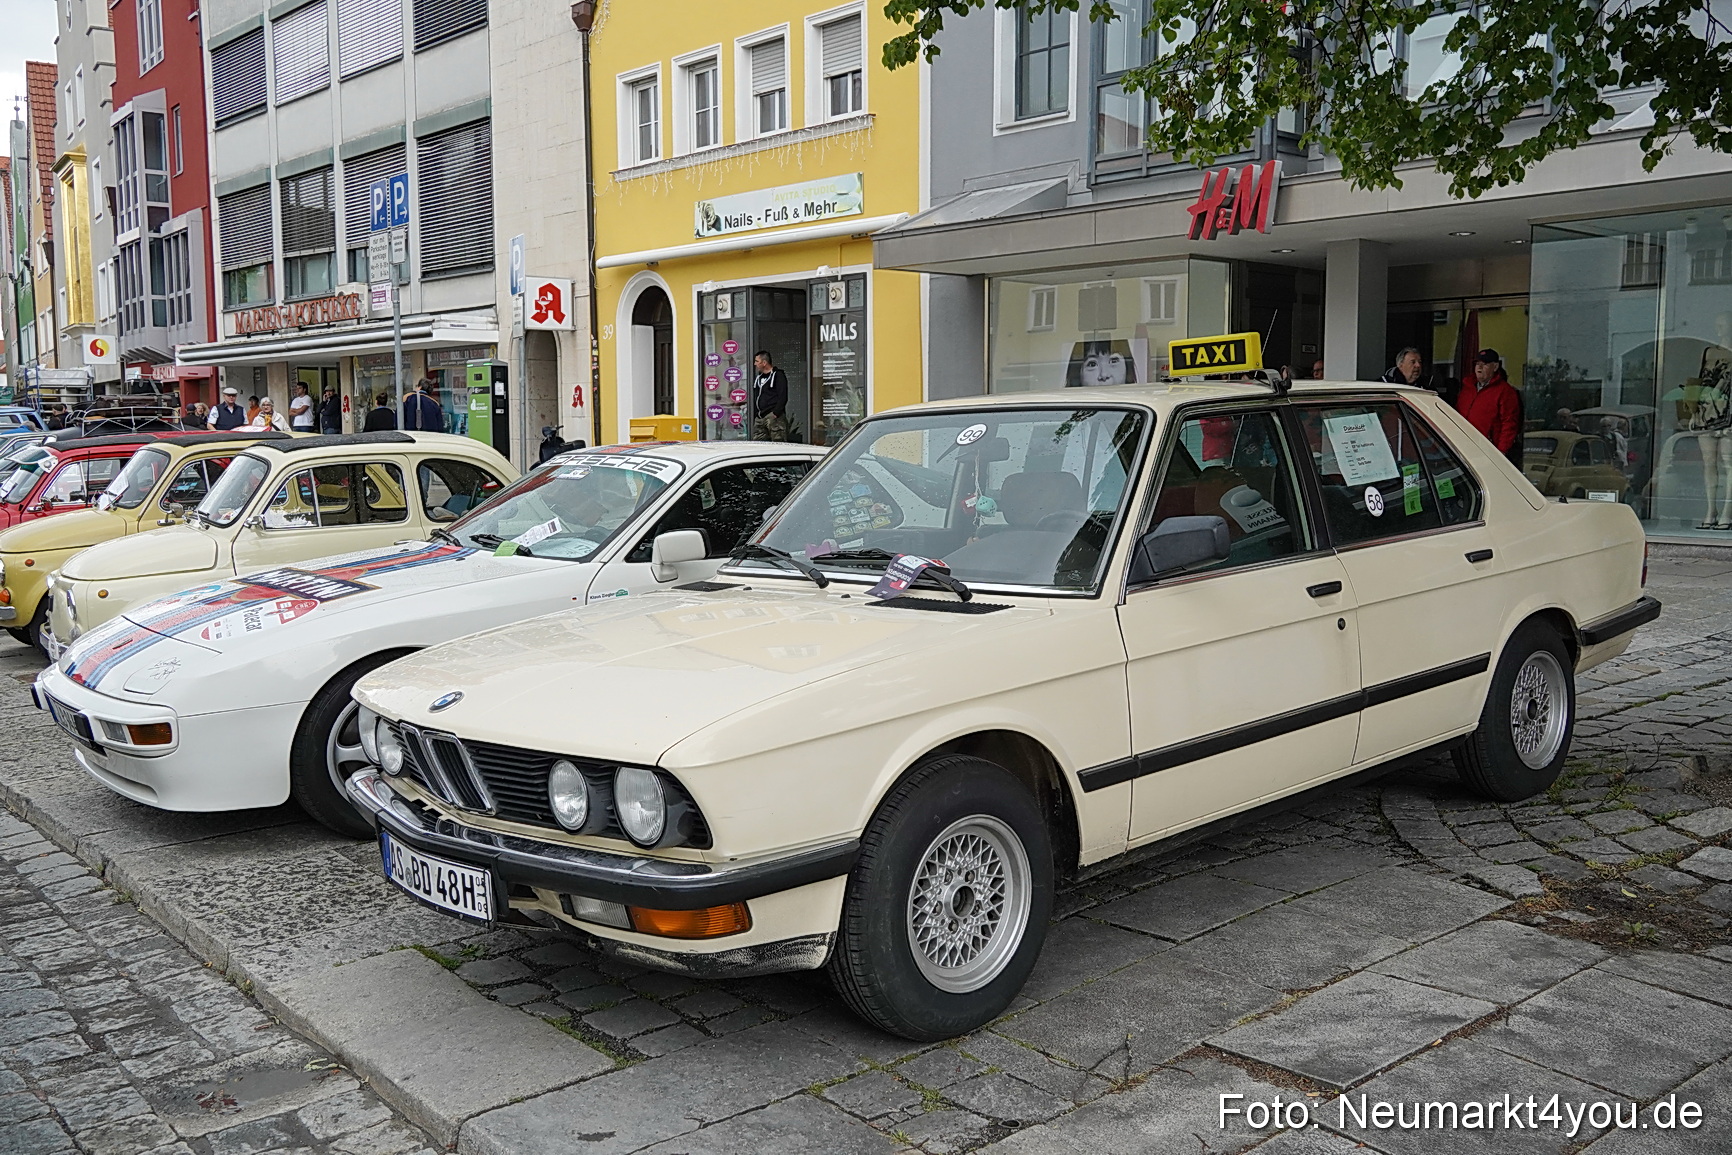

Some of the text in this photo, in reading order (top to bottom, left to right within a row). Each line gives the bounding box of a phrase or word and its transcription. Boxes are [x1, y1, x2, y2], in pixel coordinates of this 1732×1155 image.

[373, 187, 384, 225] P
[393, 181, 405, 220] P
[774, 184, 837, 202] AVITA STUDIO
[1187, 160, 1281, 240] H&M
[724, 212, 753, 230] Nails
[764, 206, 789, 223] Fuß
[792, 208, 800, 219] &
[804, 199, 838, 217] Mehr
[512, 244, 521, 288] P
[234, 292, 361, 335] MARIEN-APOTHEKE
[602, 323, 614, 340] 39
[820, 322, 858, 342] NAILS
[1181, 343, 1236, 366] TAXI
[959, 429, 984, 442] 99
[1367, 493, 1383, 511] 58
[247, 570, 361, 599] MARTINI
[390, 841, 476, 911] AS BD 48H
